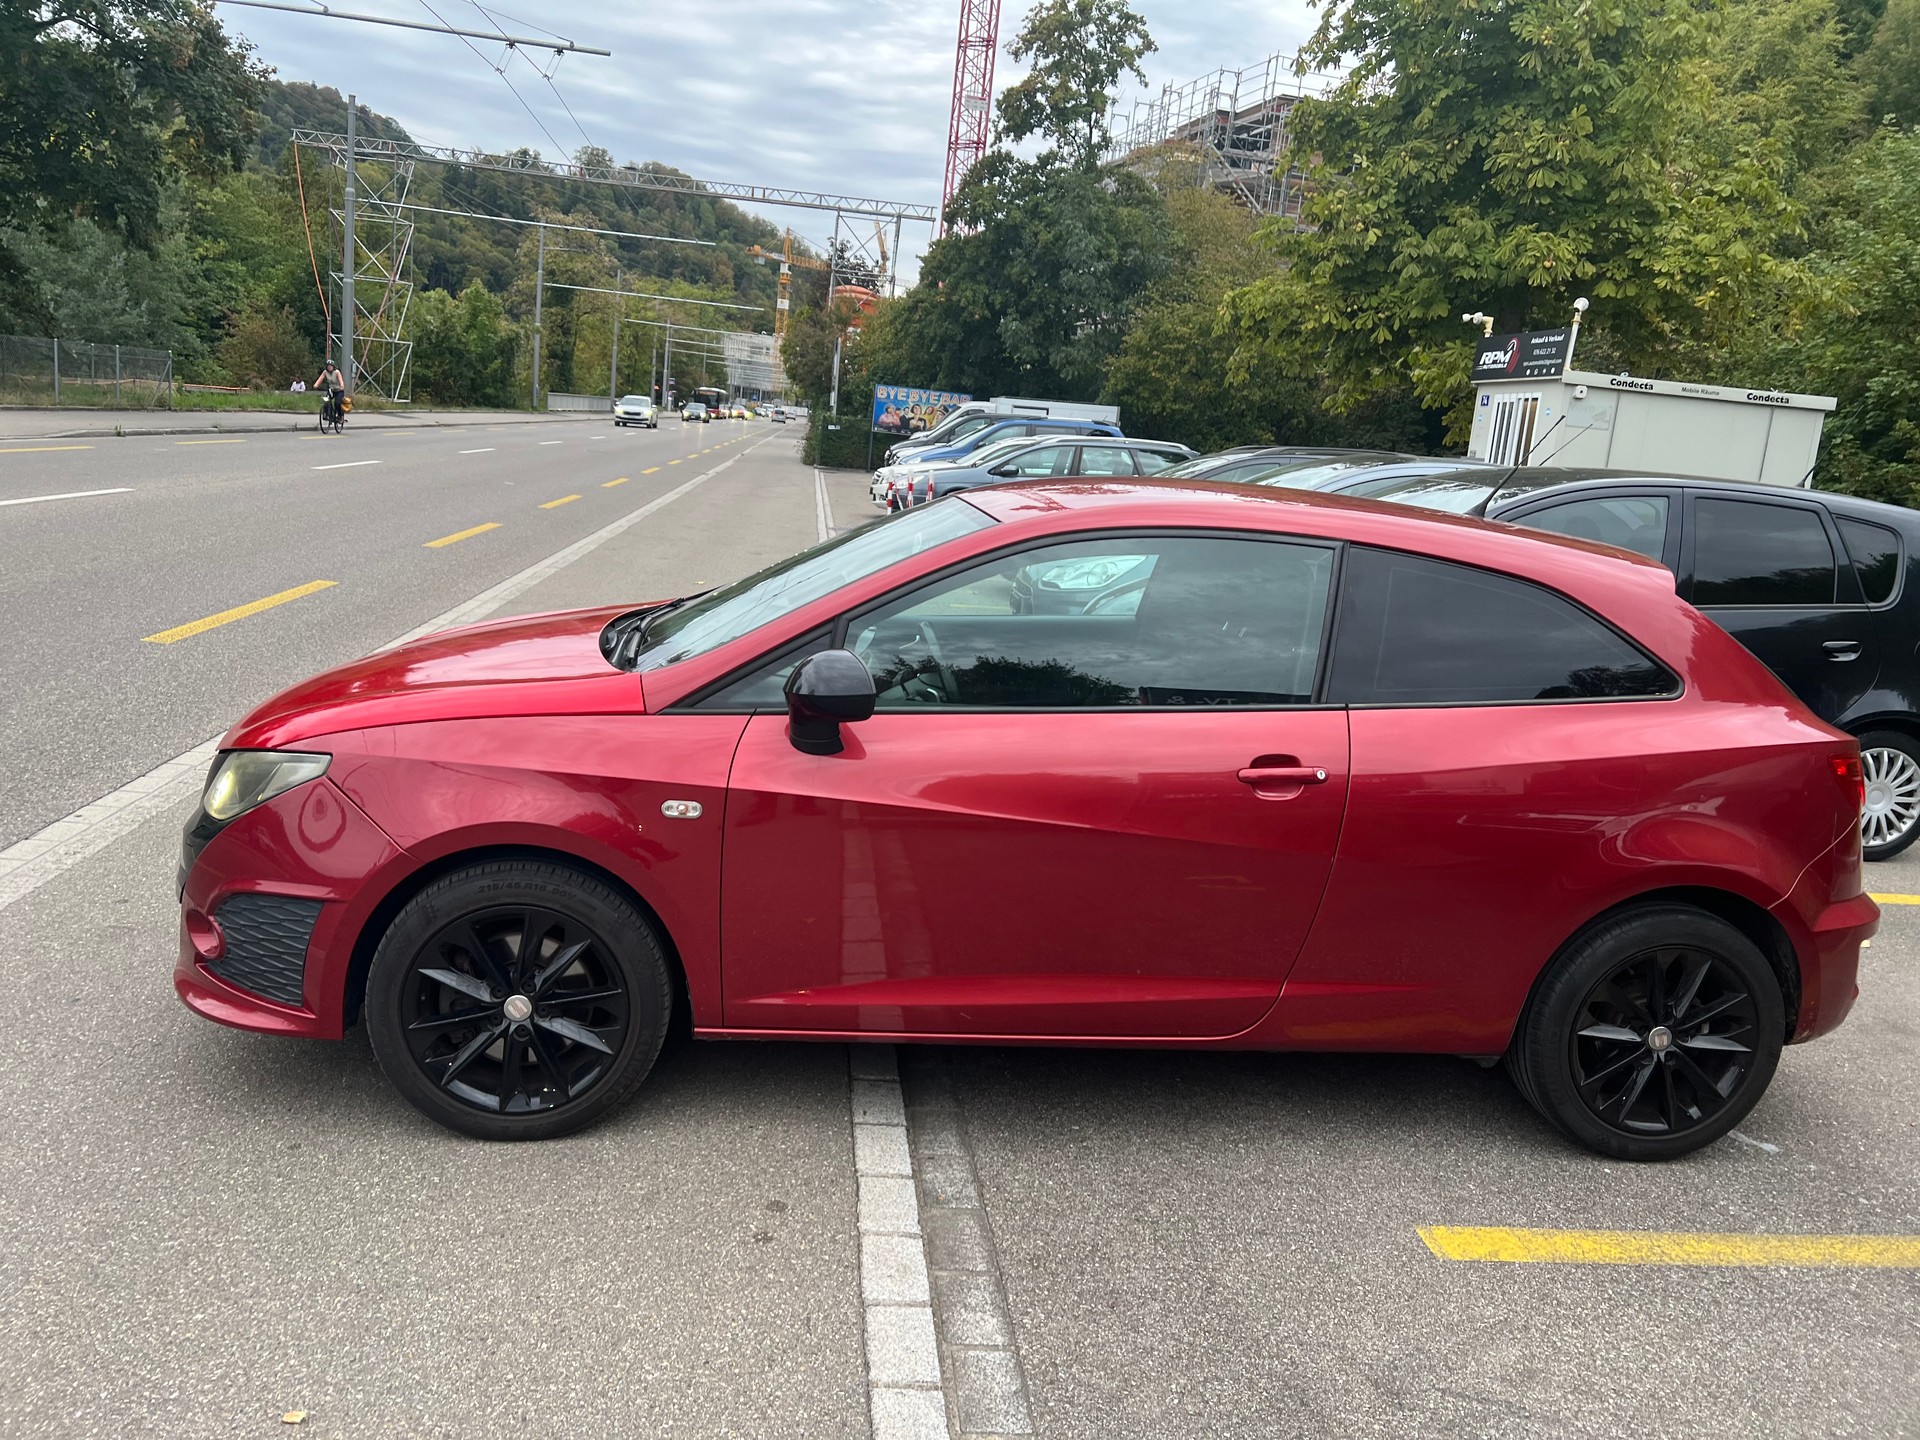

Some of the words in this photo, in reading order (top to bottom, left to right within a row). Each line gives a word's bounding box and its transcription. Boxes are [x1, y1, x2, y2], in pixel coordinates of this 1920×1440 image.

[1480, 351, 1513, 364] RPM
[1610, 378, 1654, 390] Condecta
[877, 386, 908, 400] BYE
[909, 389, 940, 404] BYE
[1746, 392, 1790, 405] Condecta
